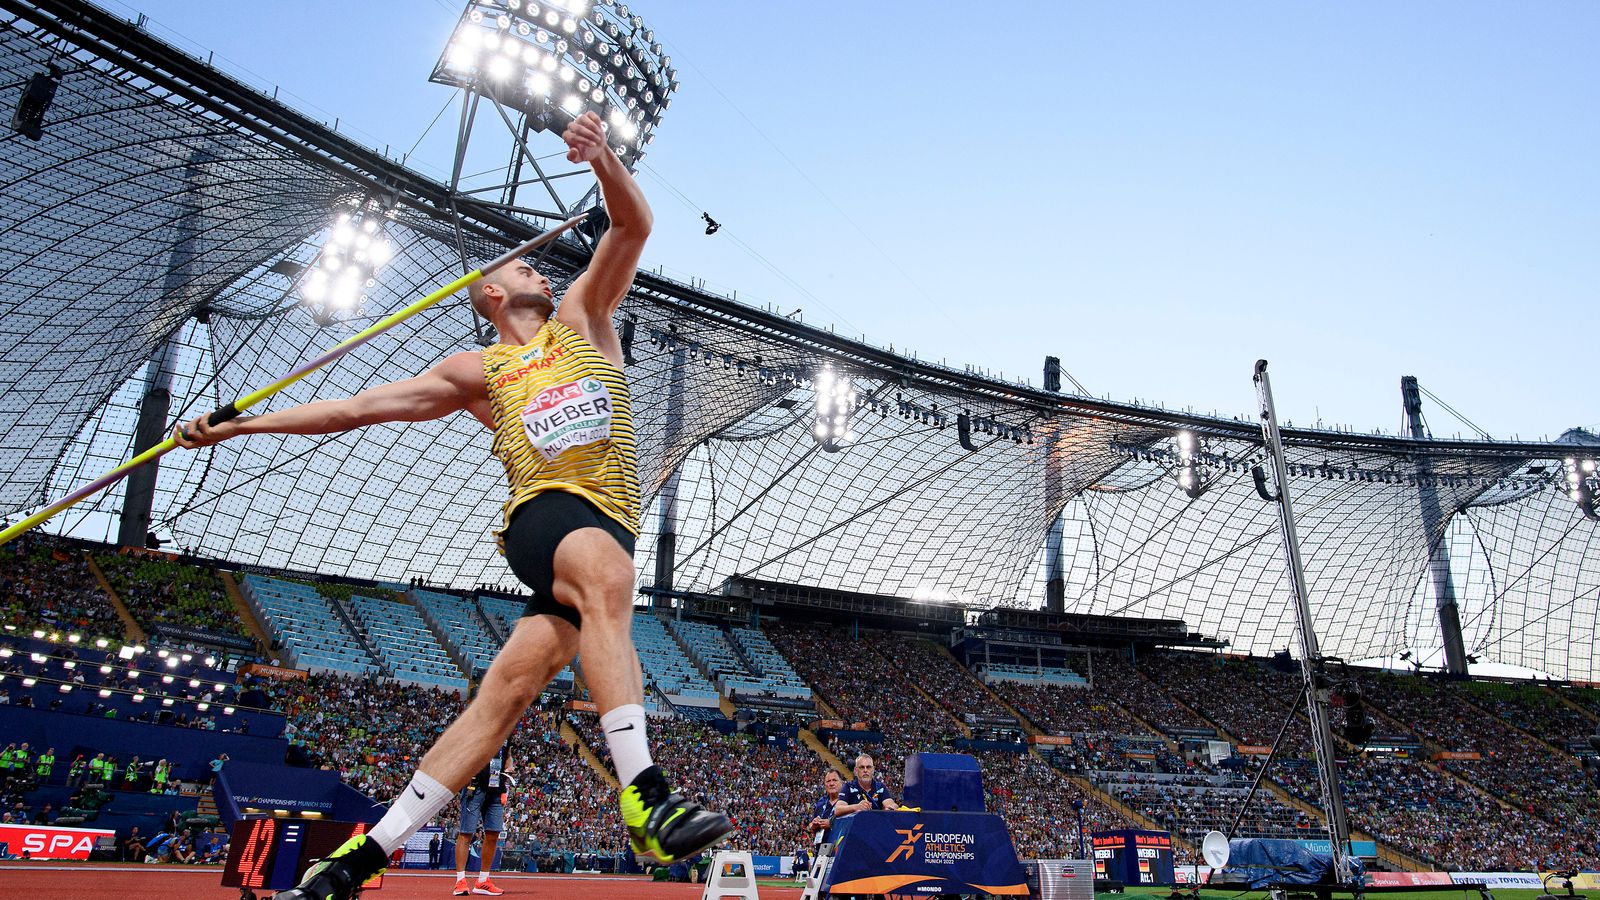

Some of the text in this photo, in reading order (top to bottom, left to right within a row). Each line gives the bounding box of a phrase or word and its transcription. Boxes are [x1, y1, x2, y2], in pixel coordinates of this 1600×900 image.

[496, 346, 564, 388] GERMANY
[523, 385, 581, 416] SPAR
[526, 397, 611, 437] WEBER
[545, 428, 608, 457] MUNICH 2022
[240, 565, 271, 575] EUROPEAN
[157, 625, 181, 634] EUROPEAN
[260, 667, 284, 677] MUNICH
[258, 797, 297, 806] CHAMPIONSHIPS
[297, 800, 319, 808] MUNICH
[21, 833, 93, 854] SPA
[924, 833, 974, 844] EUROPEAN
[238, 818, 275, 887] 42
[925, 843, 966, 853] ATHLETICS
[1137, 848, 1156, 858] WEBER
[924, 851, 975, 860] CHAMPIONSHIPS
[1094, 849, 1111, 859] WEBER
